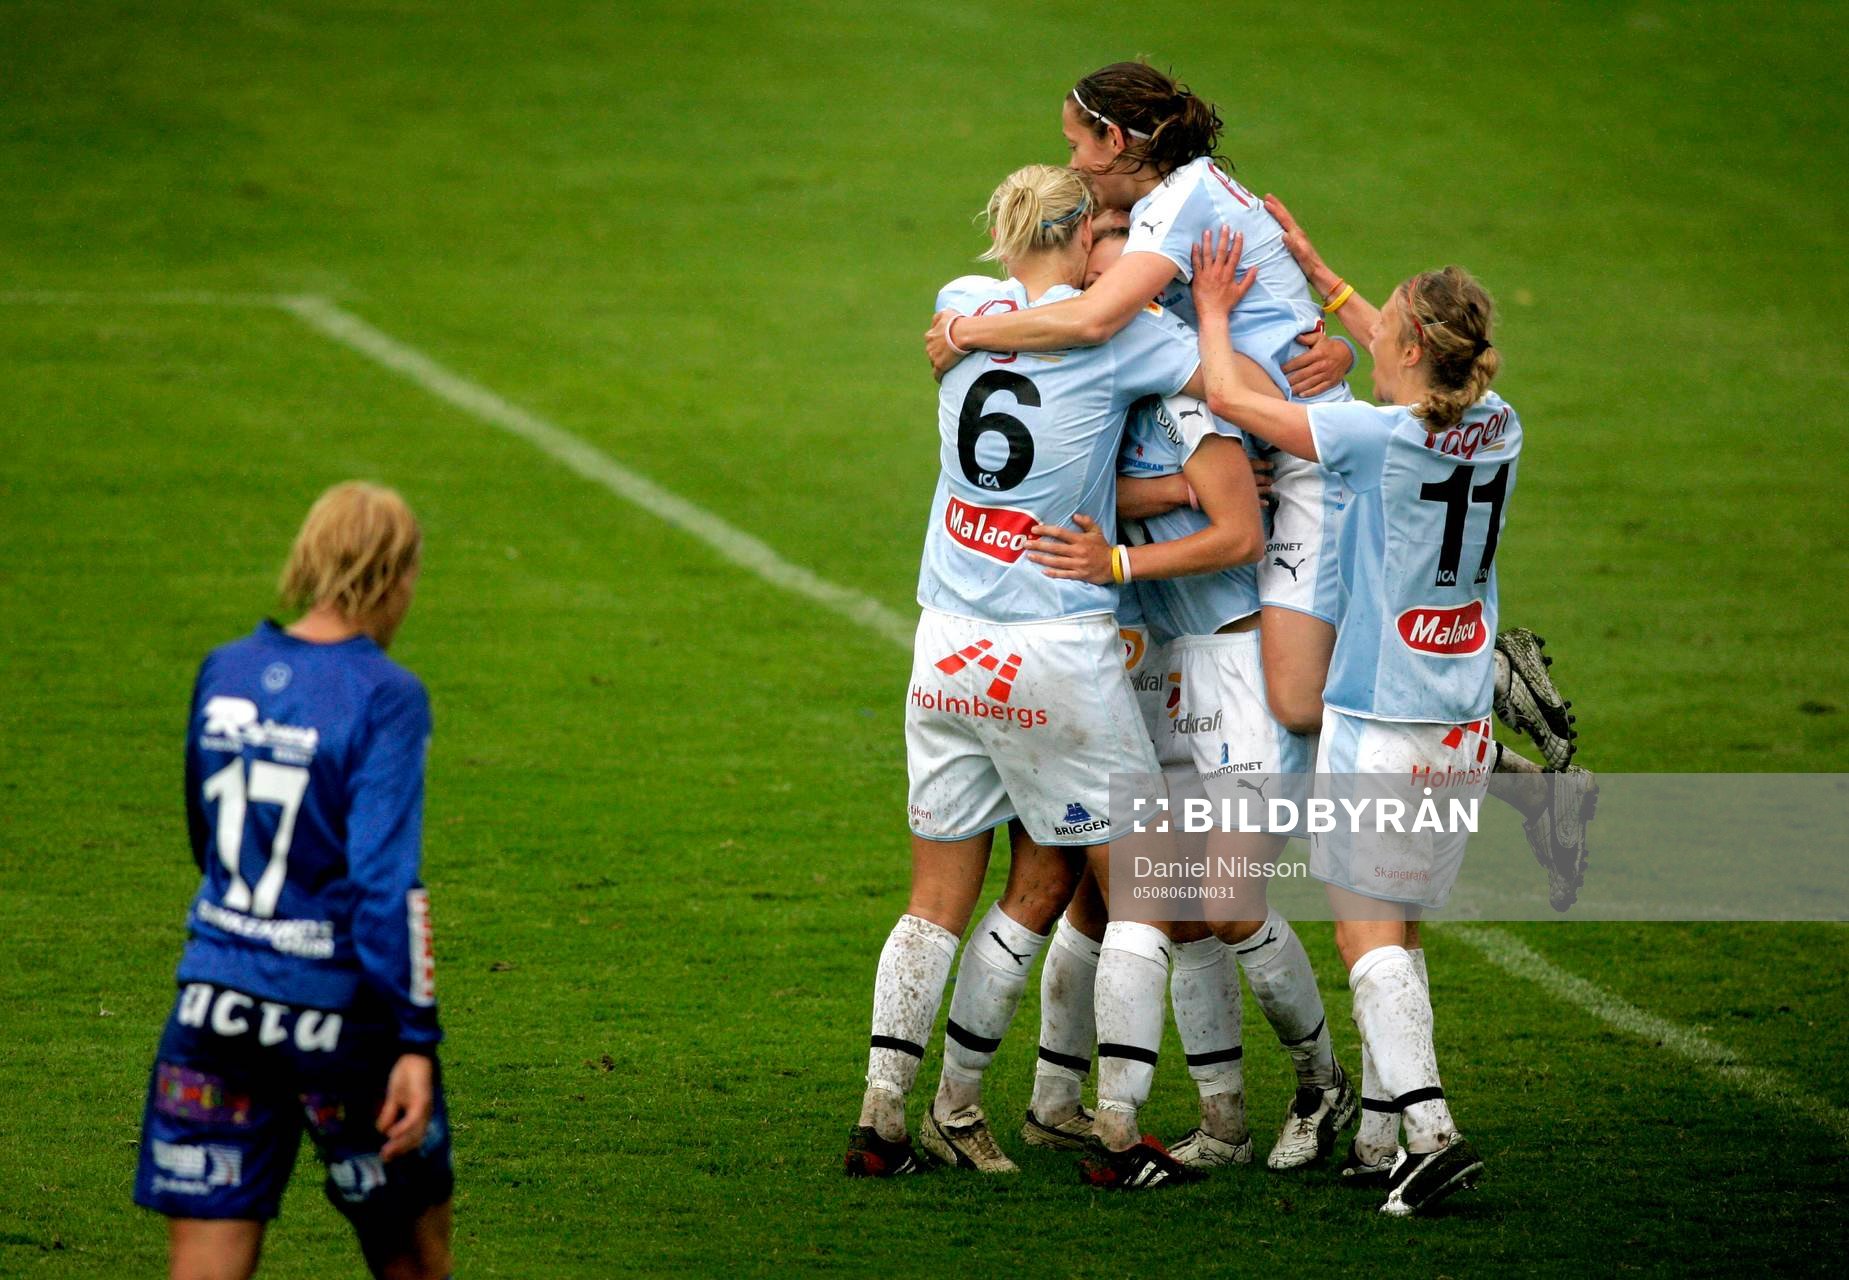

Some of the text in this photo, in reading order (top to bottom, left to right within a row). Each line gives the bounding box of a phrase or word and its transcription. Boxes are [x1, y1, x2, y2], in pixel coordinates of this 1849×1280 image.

[958, 369, 1042, 492] 6
[978, 472, 1000, 489] ICA
[950, 502, 1028, 551] Malaco
[1420, 463, 1510, 587] 11
[1266, 542, 1303, 553] ORNET
[1437, 570, 1456, 583] ICA
[1409, 614, 1477, 645] Malaco
[911, 684, 1048, 729] Holmbergs
[203, 757, 310, 919] 17
[1055, 819, 1112, 836] BRIGGEN
